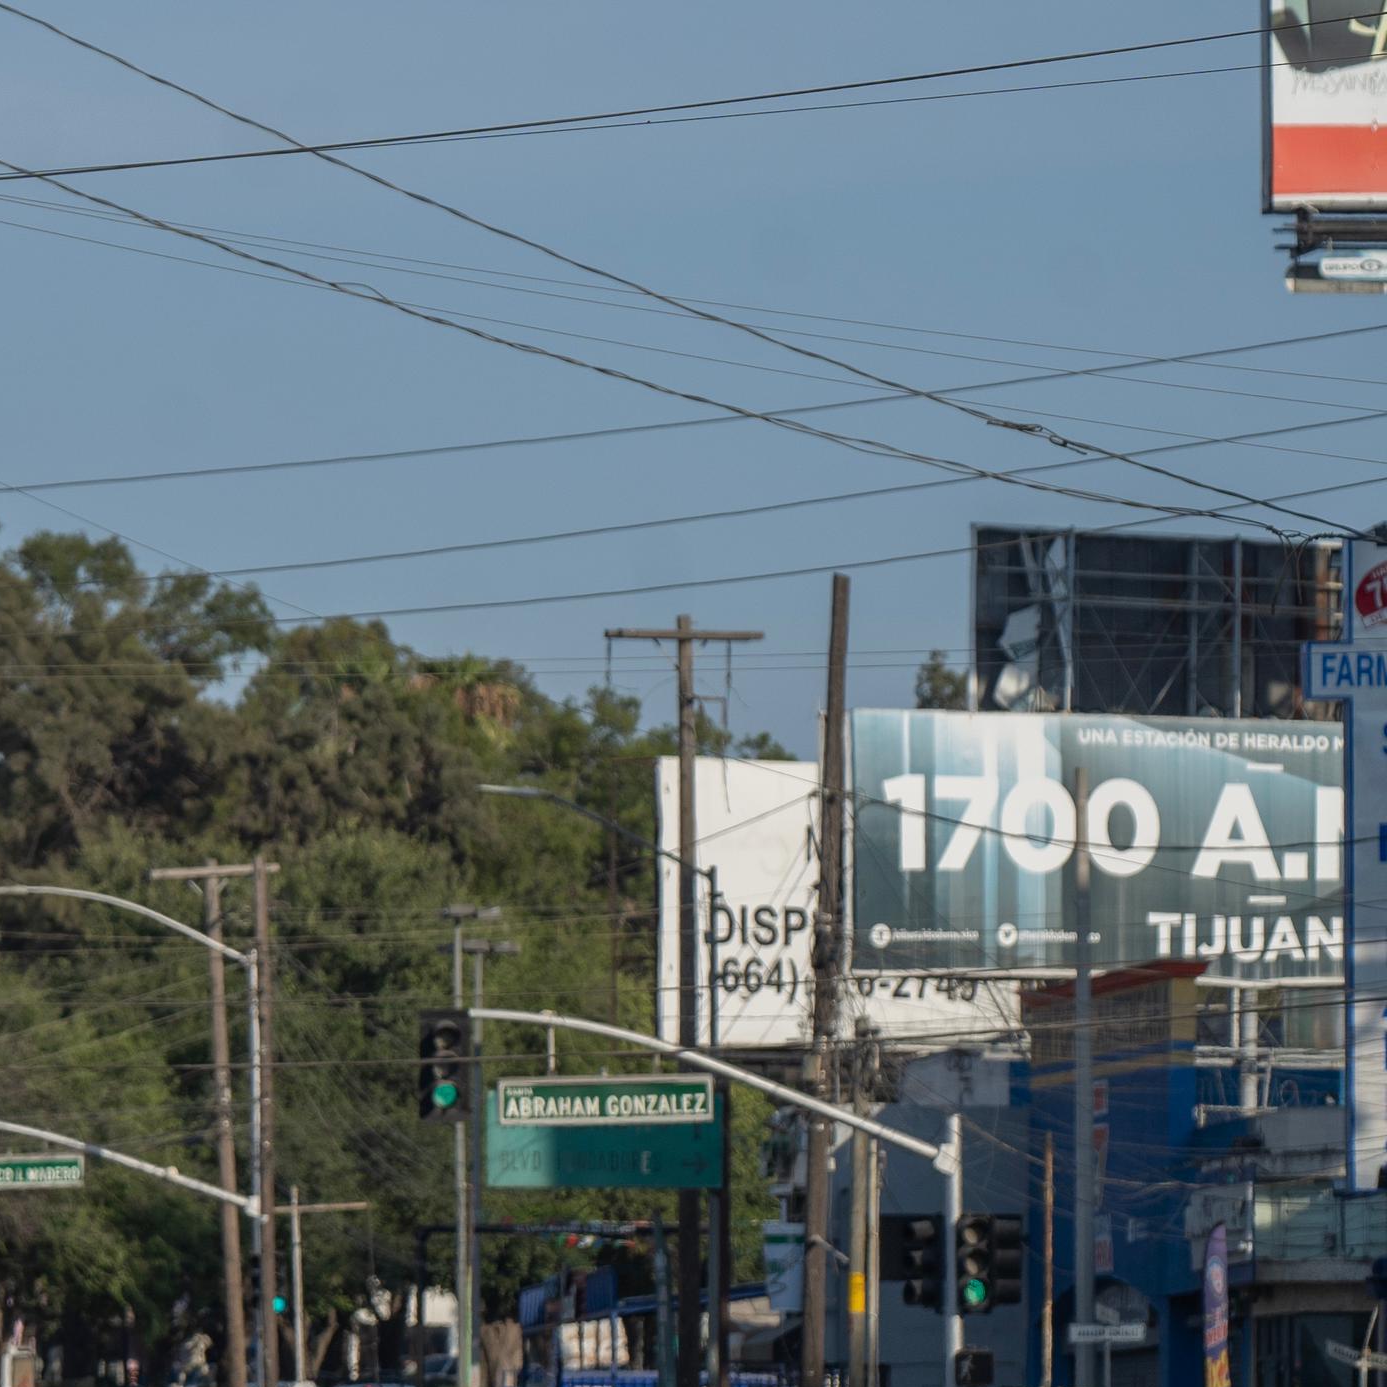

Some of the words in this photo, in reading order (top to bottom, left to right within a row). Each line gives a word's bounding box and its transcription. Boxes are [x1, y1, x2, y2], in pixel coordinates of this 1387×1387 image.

[1078, 727, 1116, 744] UNA
[1122, 728, 1211, 747] ESTACIÓN
[1215, 731, 1240, 747] DE
[1244, 732, 1328, 751] HERALDO
[882, 773, 1161, 877] 1700
[714, 957, 800, 1004] 664)
[505, 1096, 600, 1117] ABRAHAM
[605, 1092, 707, 1116] GONZALEZ
[29, 1164, 81, 1182] MADERO
